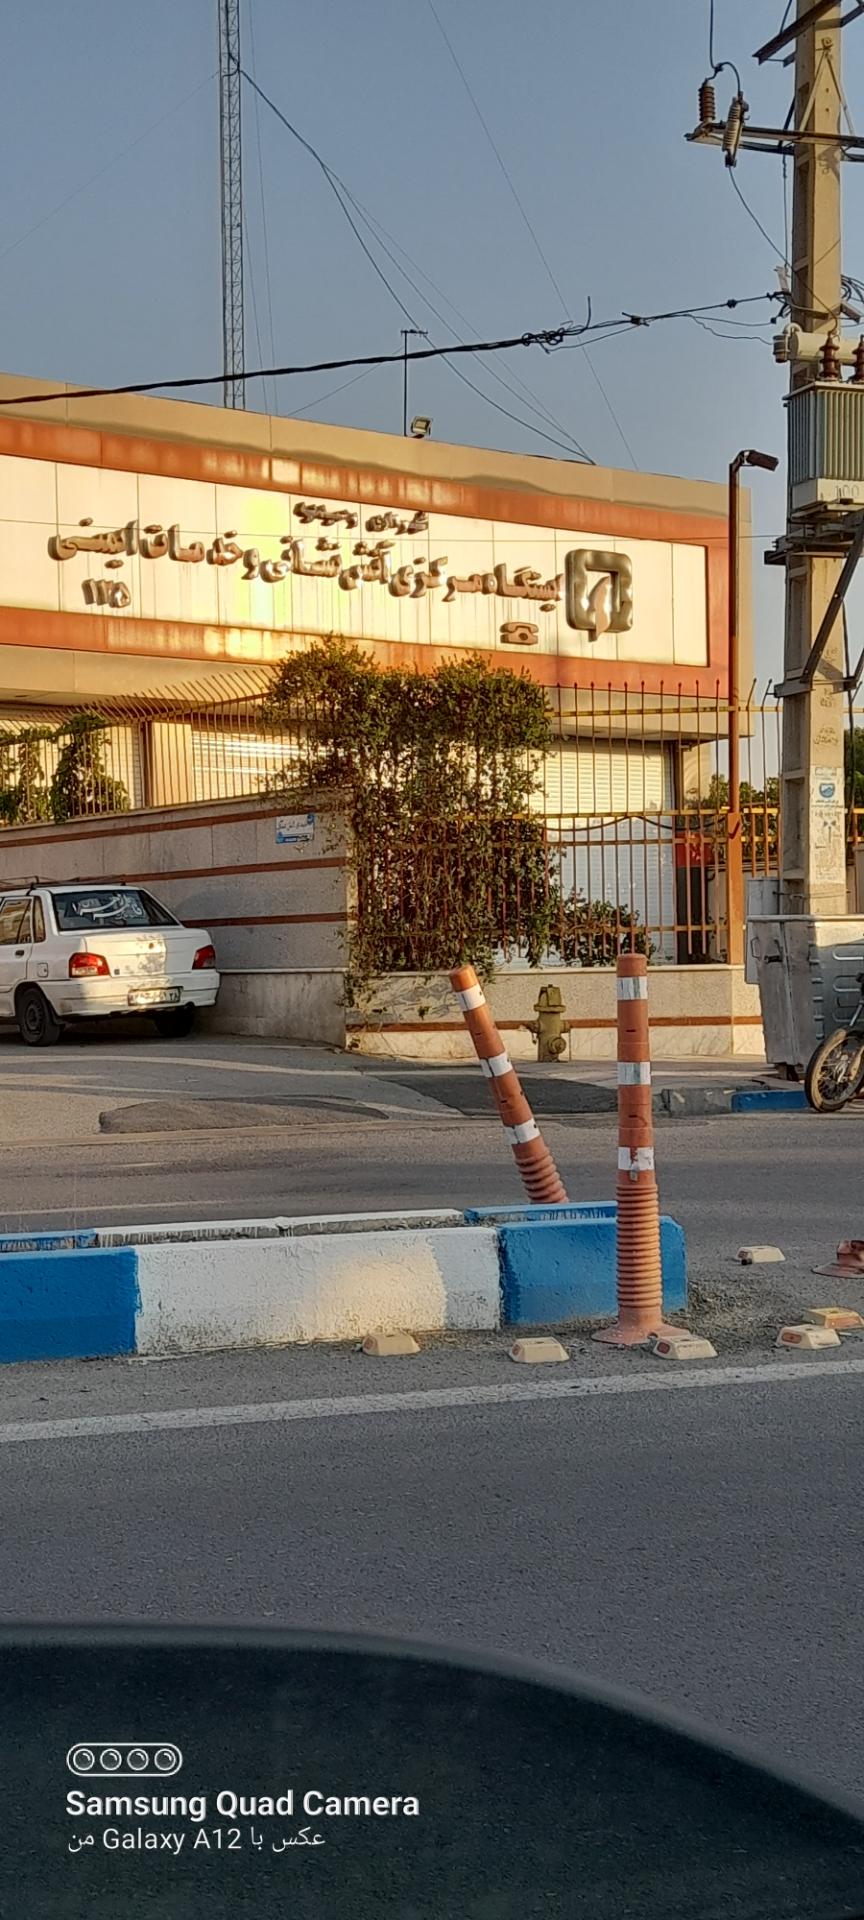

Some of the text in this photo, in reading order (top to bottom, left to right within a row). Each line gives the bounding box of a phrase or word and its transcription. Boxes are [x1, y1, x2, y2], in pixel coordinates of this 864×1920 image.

[365, 509, 429, 536] شهرداری
[47, 516, 564, 613] ایستگاه مرکزی آتش نشانی و خدمات ایمنی
